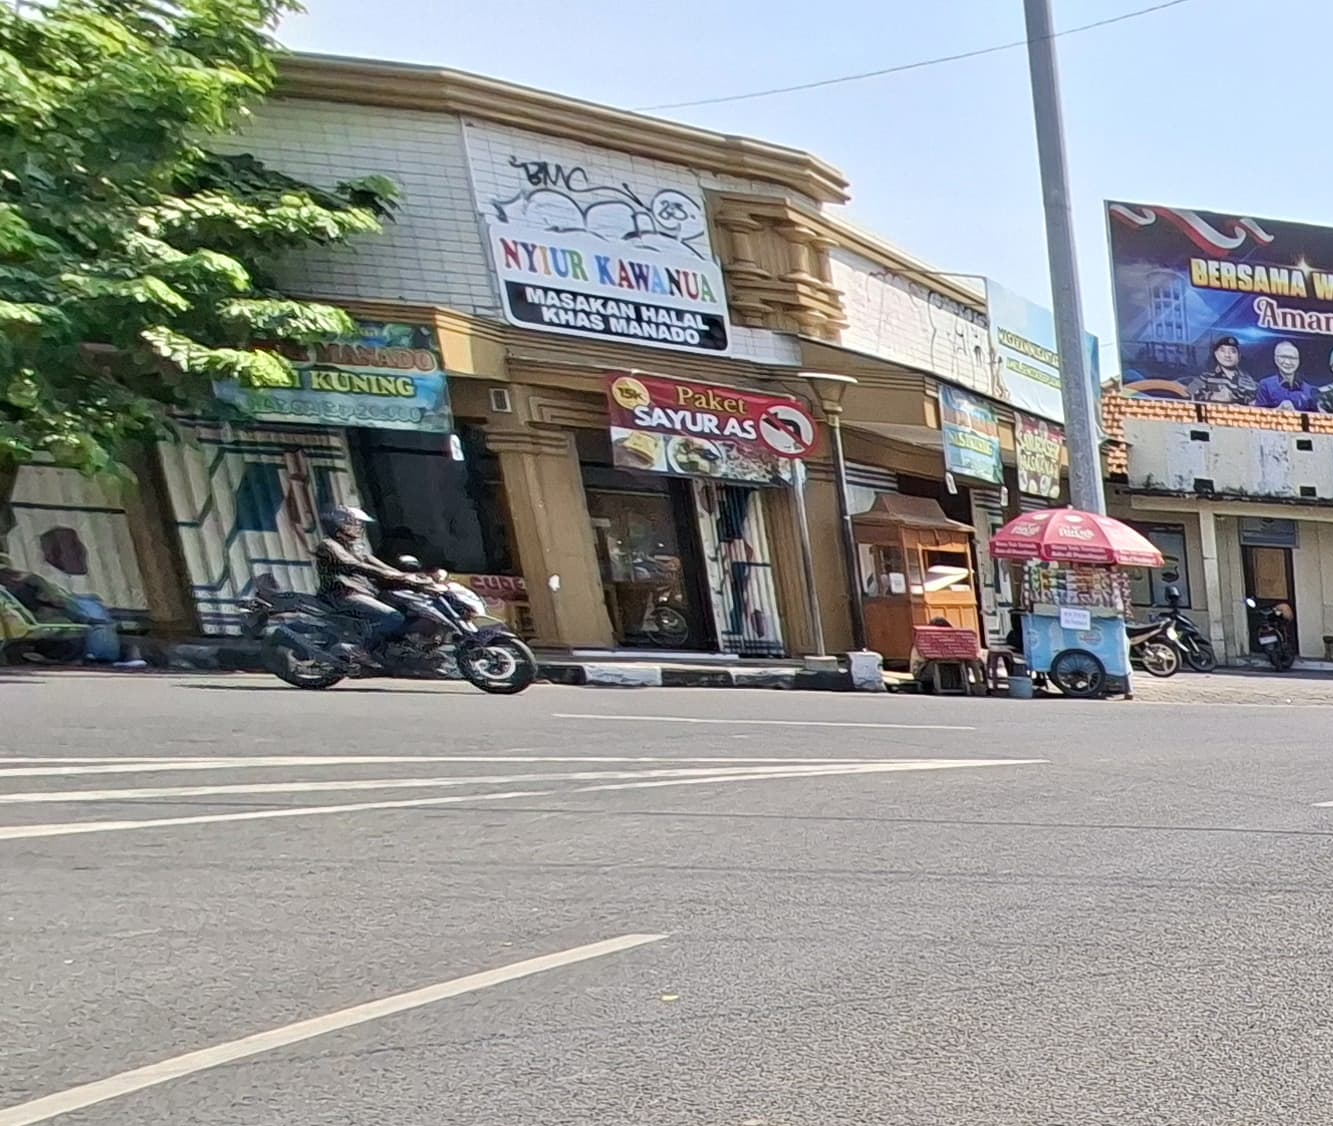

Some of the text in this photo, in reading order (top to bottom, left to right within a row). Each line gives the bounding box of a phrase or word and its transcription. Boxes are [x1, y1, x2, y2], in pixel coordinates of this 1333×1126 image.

[595, 254, 718, 303] KAWANUA
[1190, 257, 1307, 298] BERSAMA
[526, 286, 709, 331] MASAKAN HALAL
[542, 308, 700, 345] KHAS MANADO
[311, 370, 416, 397] KUNING
[675, 385, 747, 414] Paket
[634, 405, 757, 440] SAYUR AS
